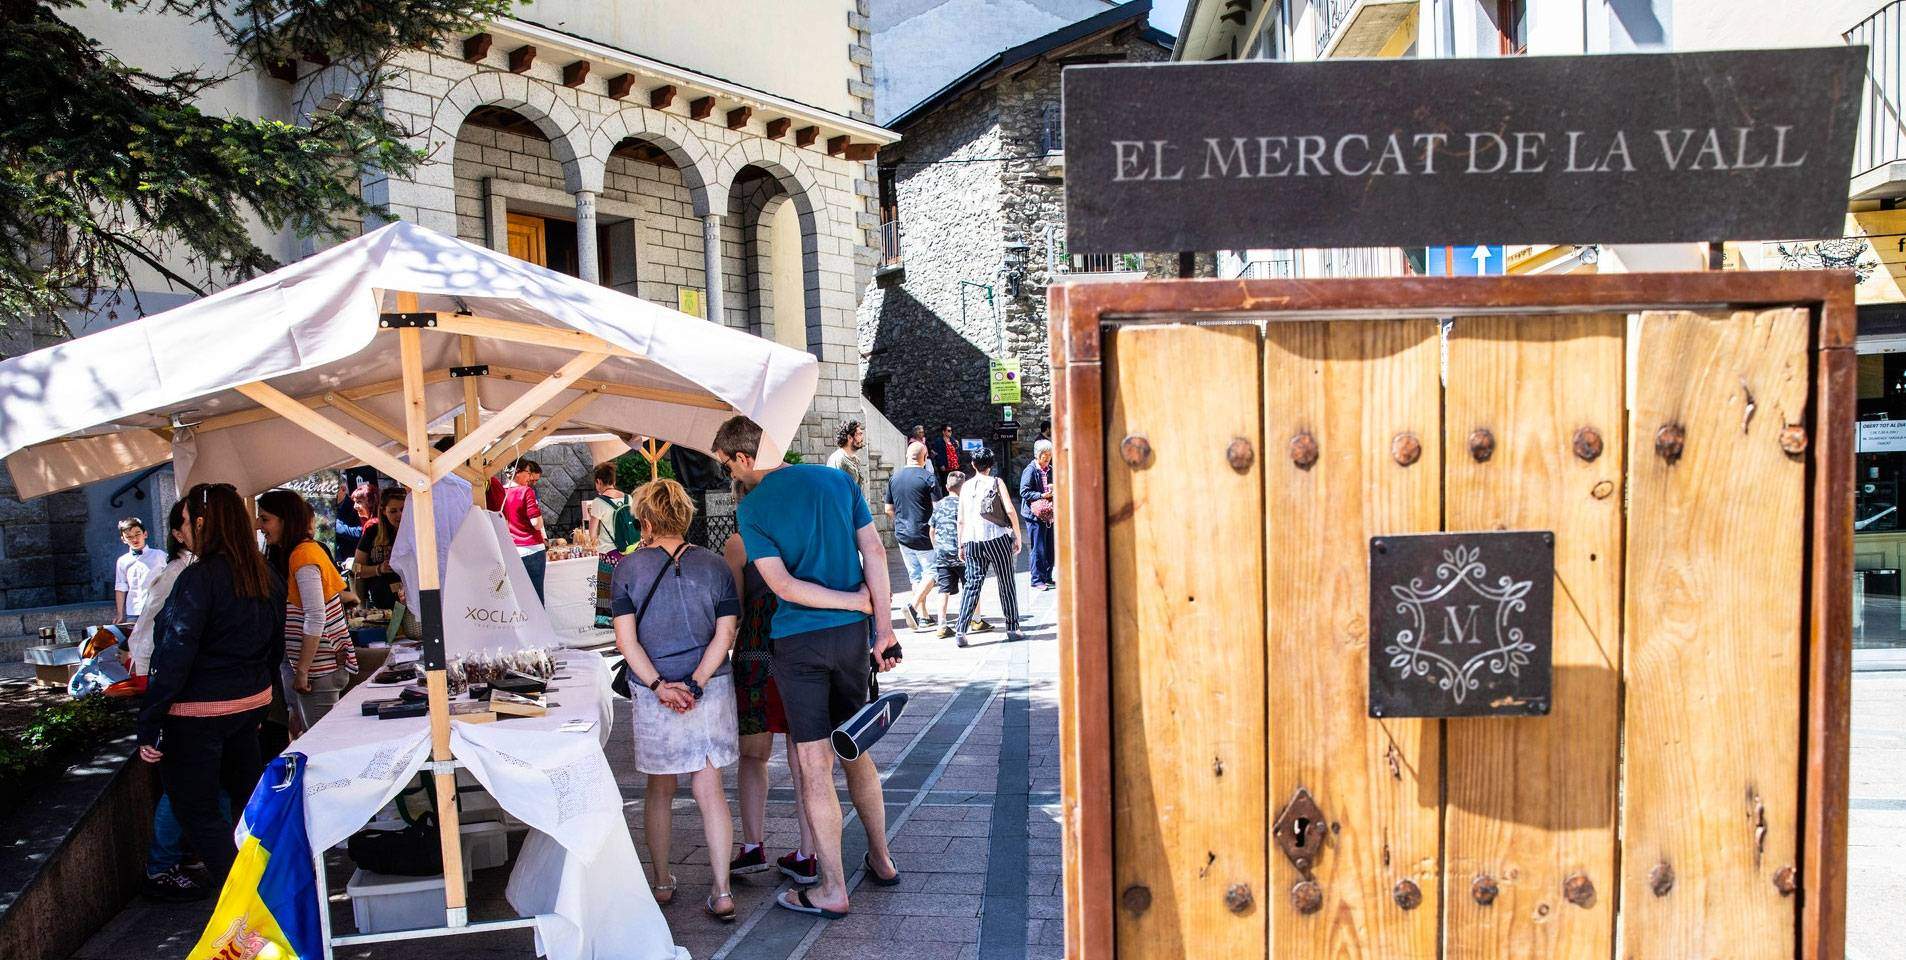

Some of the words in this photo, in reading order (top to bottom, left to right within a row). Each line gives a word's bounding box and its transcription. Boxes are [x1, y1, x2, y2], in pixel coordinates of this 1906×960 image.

[1111, 140, 1184, 182] EL
[1201, 133, 1448, 180] MERCAT
[1464, 131, 1547, 174] DE
[1563, 130, 1637, 172] LA
[1653, 125, 1808, 170] VALL
[1438, 604, 1482, 644] M
